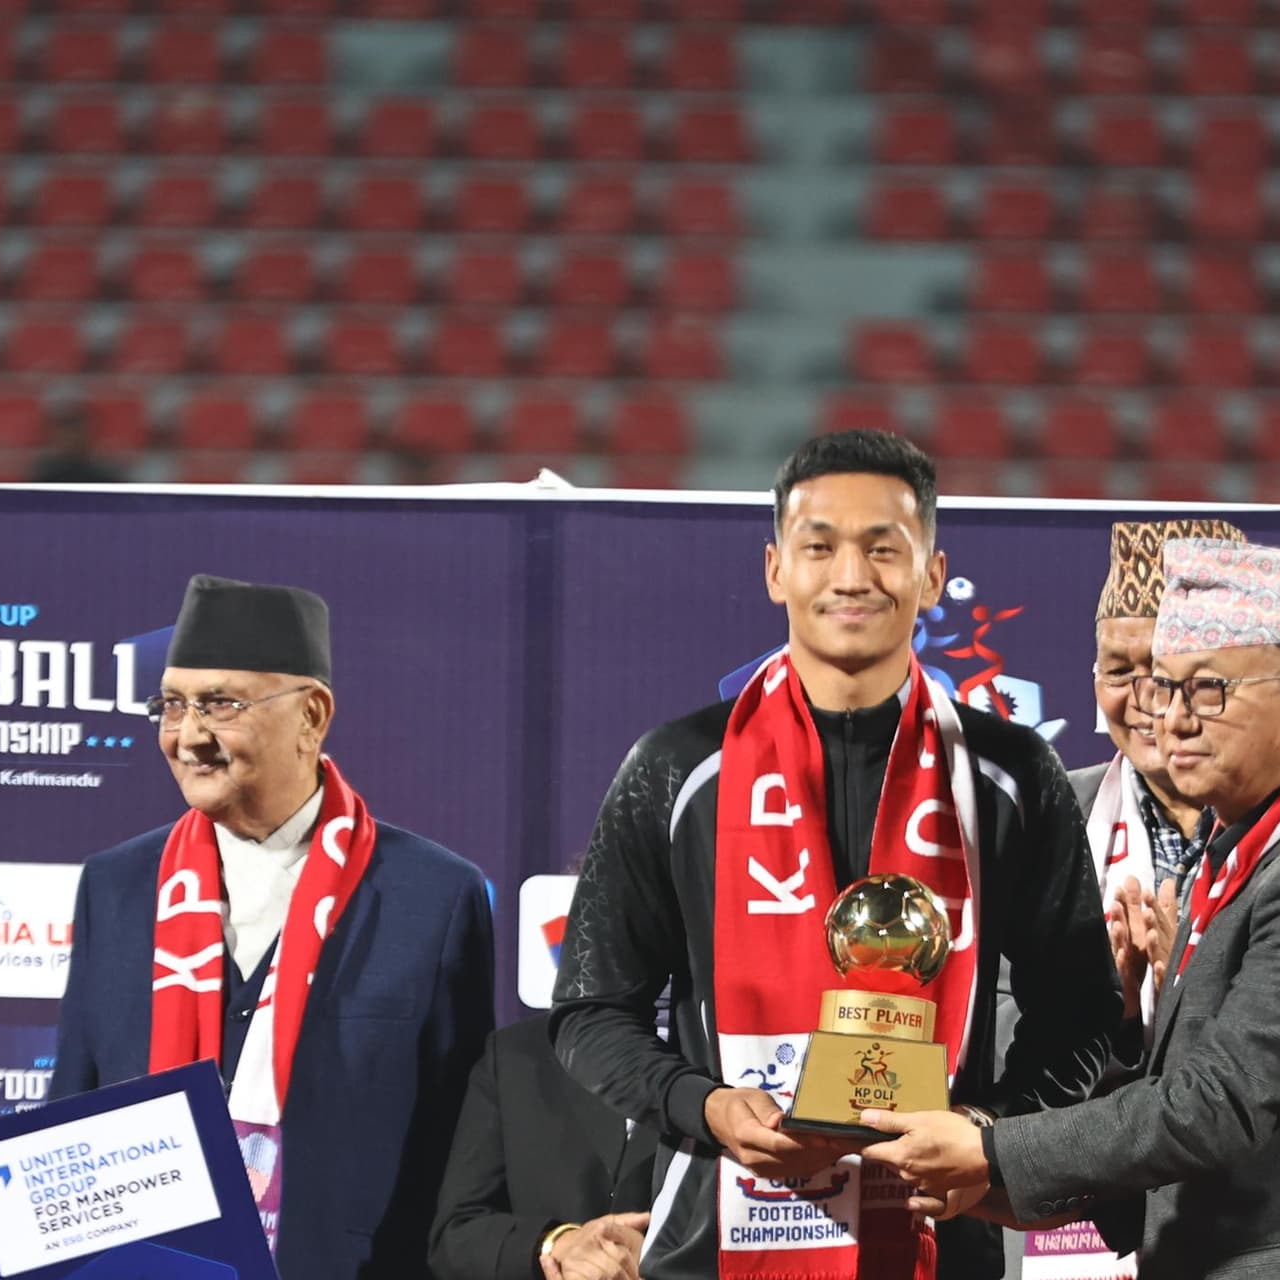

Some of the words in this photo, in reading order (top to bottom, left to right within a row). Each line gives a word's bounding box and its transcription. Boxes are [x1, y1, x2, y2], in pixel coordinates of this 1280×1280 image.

[0, 769, 102, 789] Kathmandu
[838, 1006, 871, 1021] BEST
[876, 1008, 924, 1029] PLAYER
[854, 1086, 872, 1098] KP
[873, 1088, 894, 1101] OLI
[19, 1142, 93, 1173] UNITED
[24, 1135, 183, 1189] INTERNATIONAL
[29, 1175, 98, 1206] GROUP
[33, 1199, 72, 1221] FOR
[76, 1168, 184, 1209] MANPOWER
[38, 1200, 125, 1236] SERVICES
[748, 1203, 833, 1222] FOOTBALL
[45, 1241, 61, 1252] AN
[86, 1218, 140, 1241] COMPANY
[730, 1221, 850, 1244] CHAMPIONSHIP
